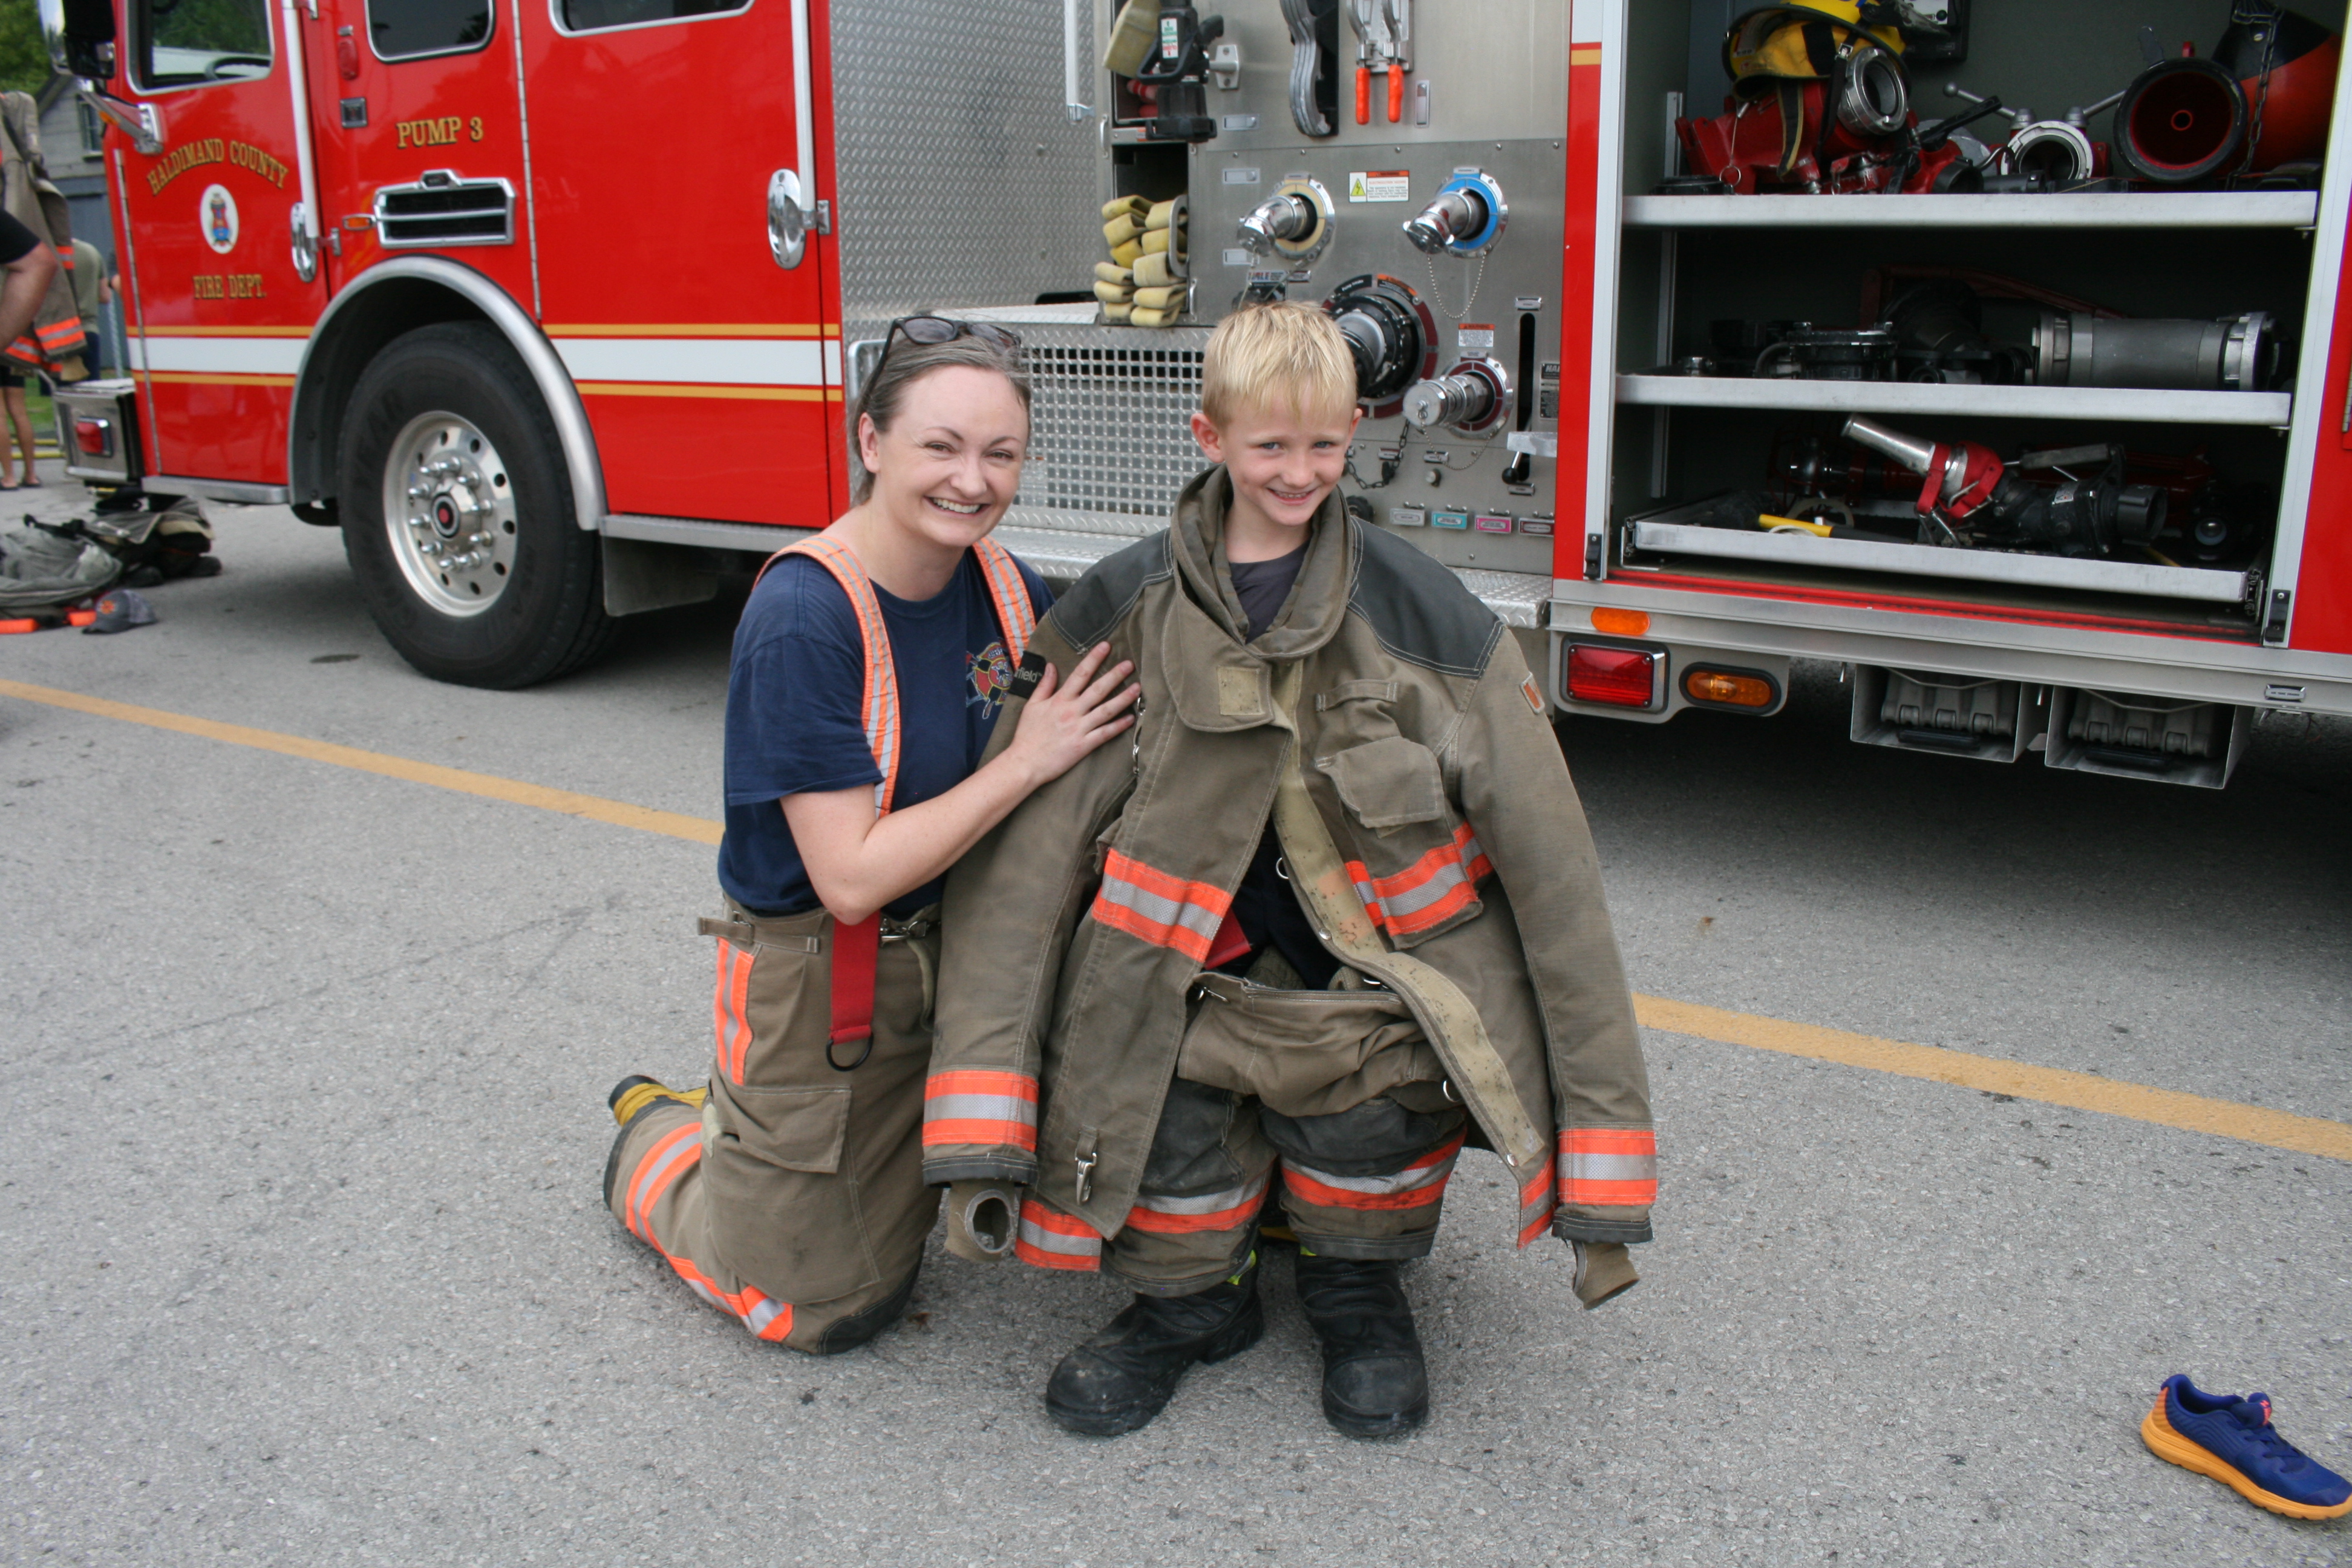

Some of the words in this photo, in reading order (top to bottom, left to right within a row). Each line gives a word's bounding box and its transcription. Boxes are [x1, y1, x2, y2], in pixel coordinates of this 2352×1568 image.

[396, 116, 462, 148] PUMP
[469, 116, 484, 142] 3
[147, 138, 225, 196] HALDIMAND
[229, 140, 289, 189] COUNTY
[193, 275, 224, 299] FIRE
[227, 273, 267, 298] DEPT.
